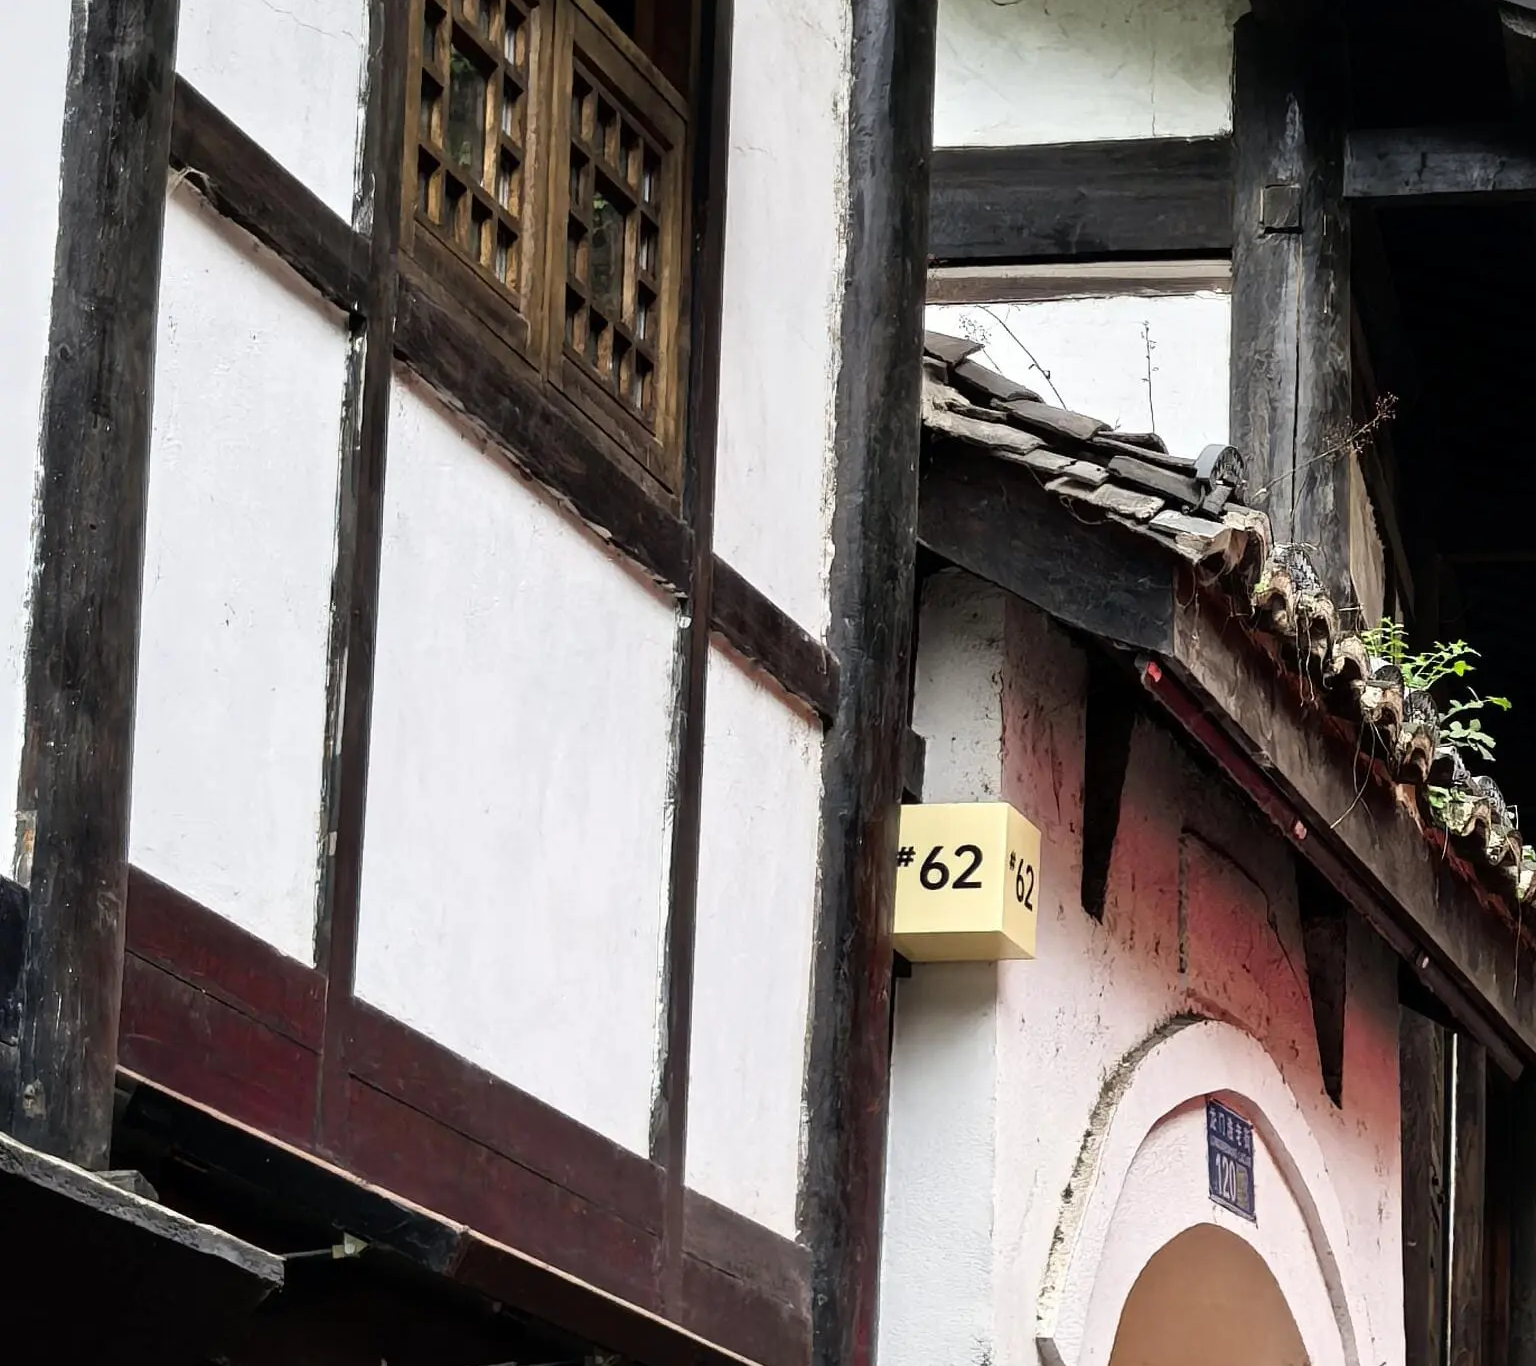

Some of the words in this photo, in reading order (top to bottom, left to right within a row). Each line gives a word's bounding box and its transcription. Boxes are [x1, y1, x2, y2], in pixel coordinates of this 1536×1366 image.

[896, 844, 983, 890] #62
[1009, 851, 1035, 912] #62
[1215, 1153, 1236, 1202] 120
